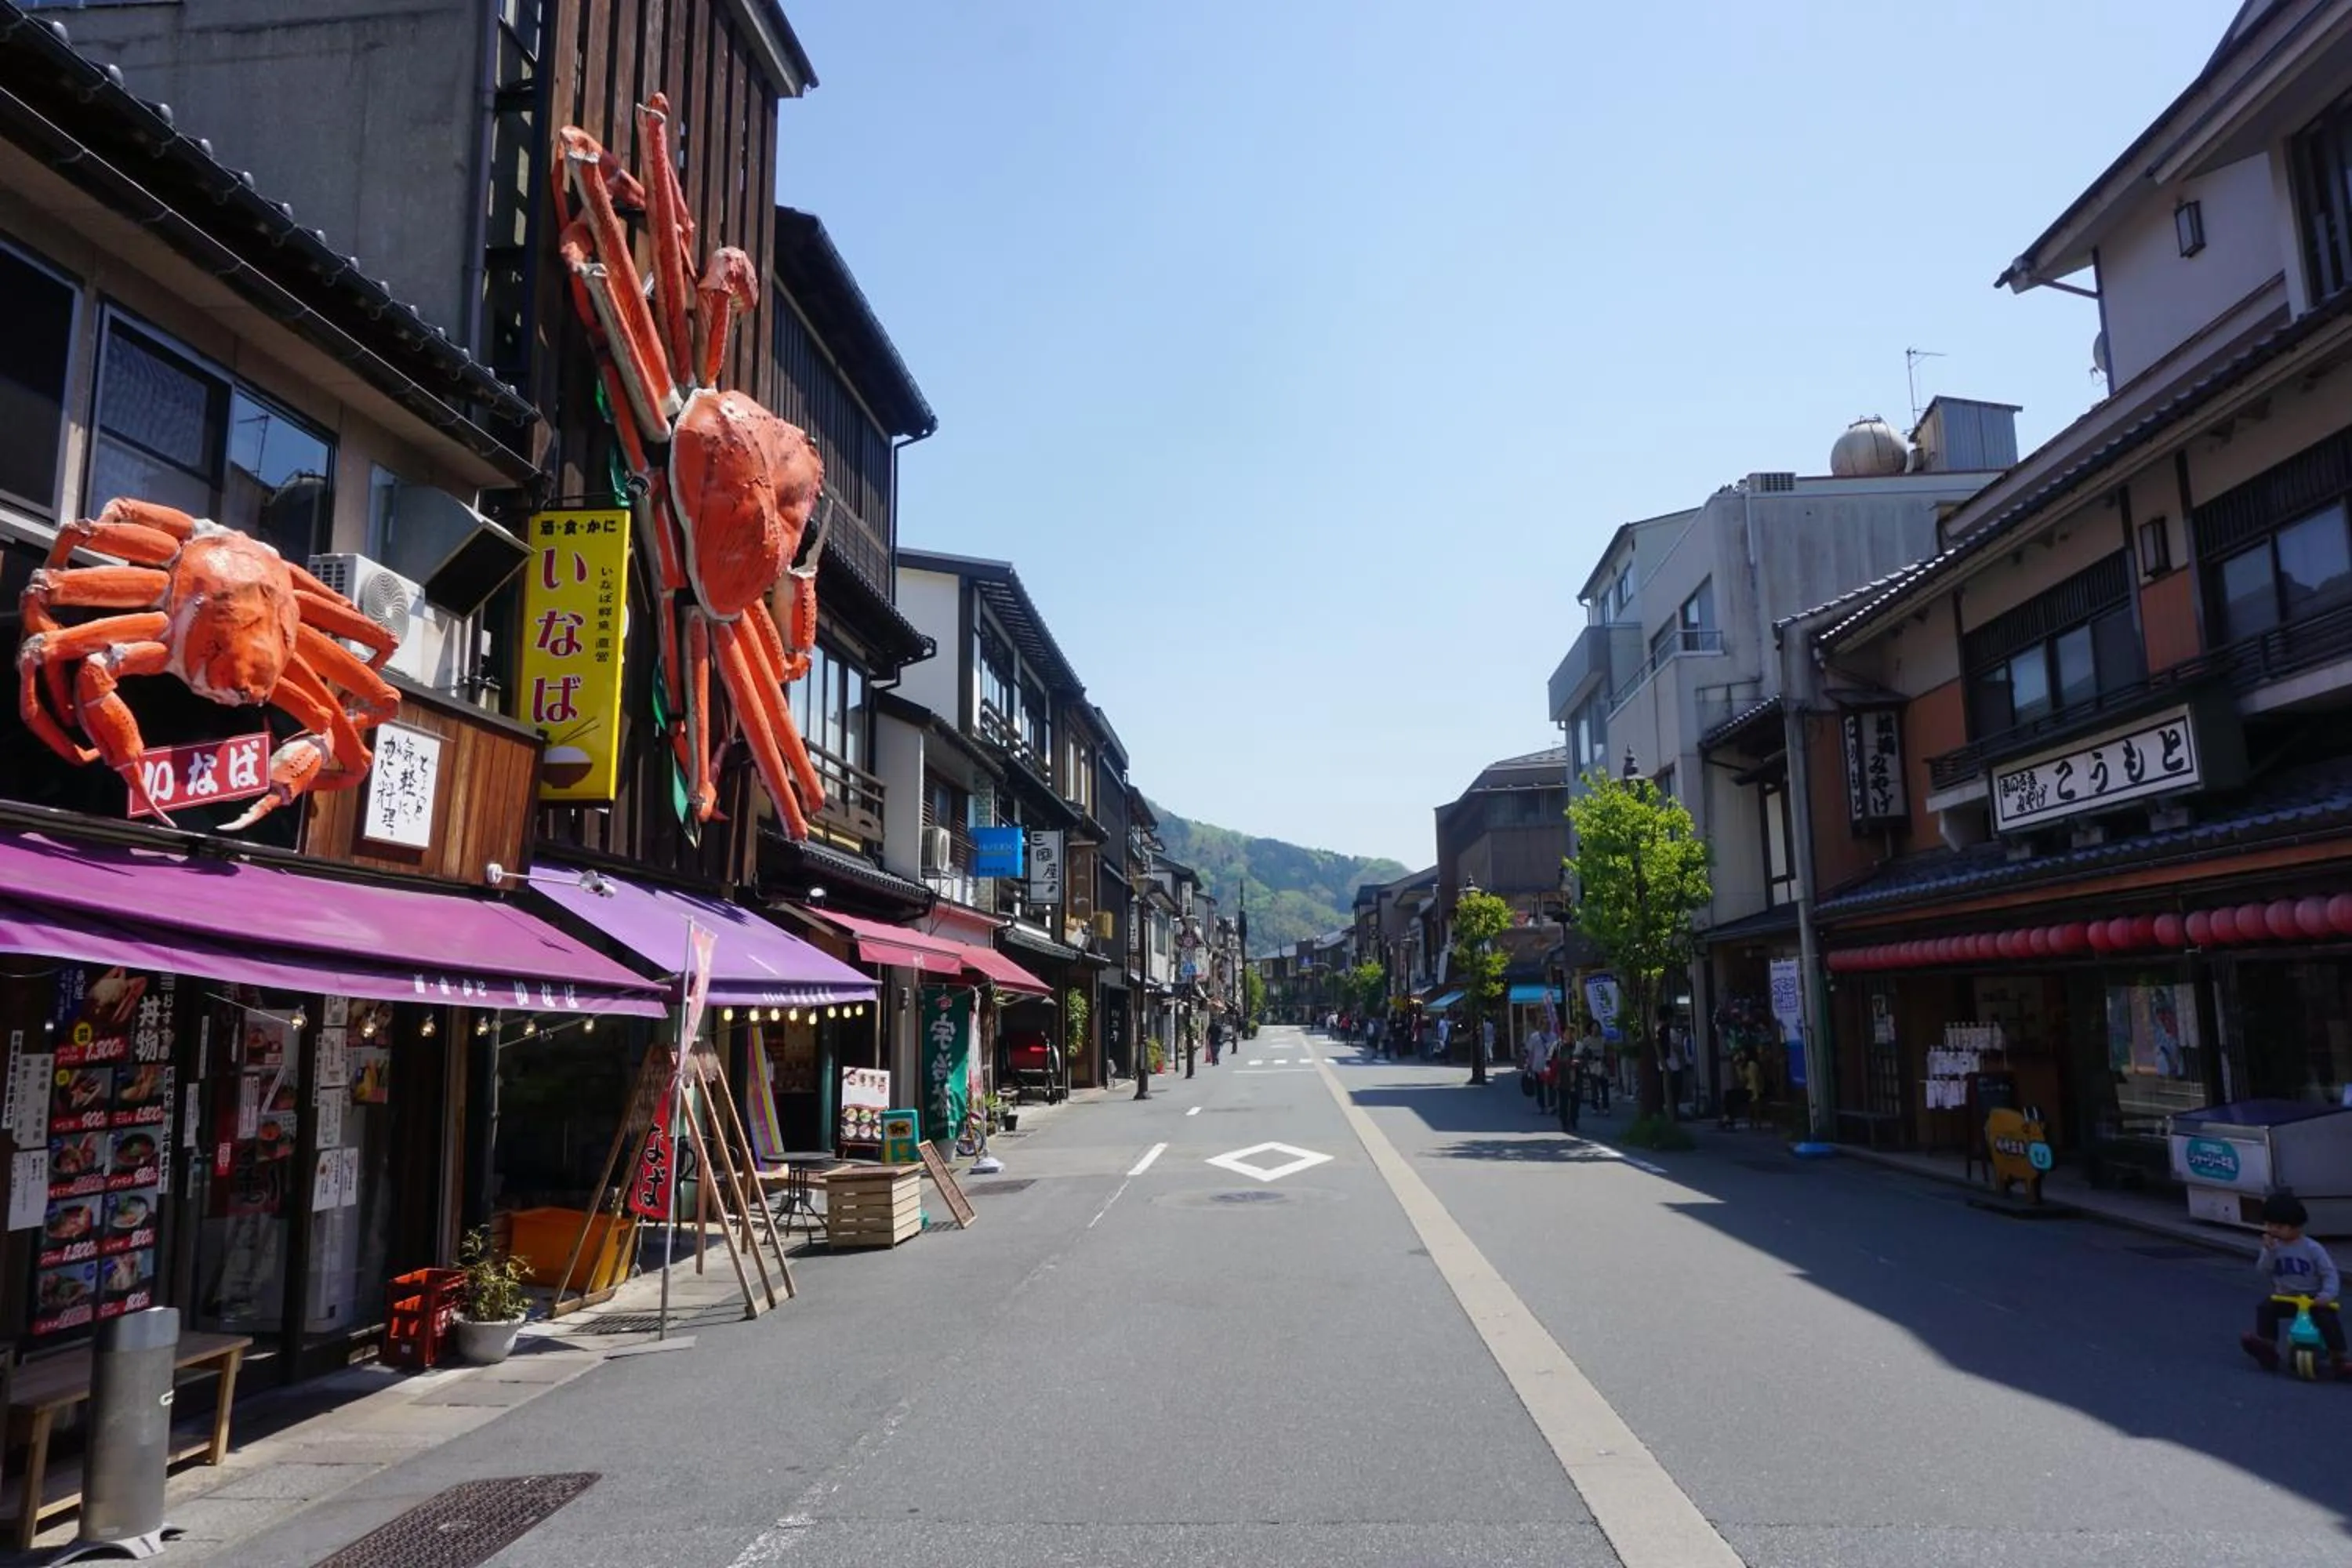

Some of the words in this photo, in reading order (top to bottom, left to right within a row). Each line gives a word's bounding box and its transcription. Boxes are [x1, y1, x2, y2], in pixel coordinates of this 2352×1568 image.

[532, 546, 588, 723] いなば
[2002, 771, 2038, 797] きのさき
[2055, 728, 2185, 800] こうもと
[2016, 784, 2049, 813] みやげ
